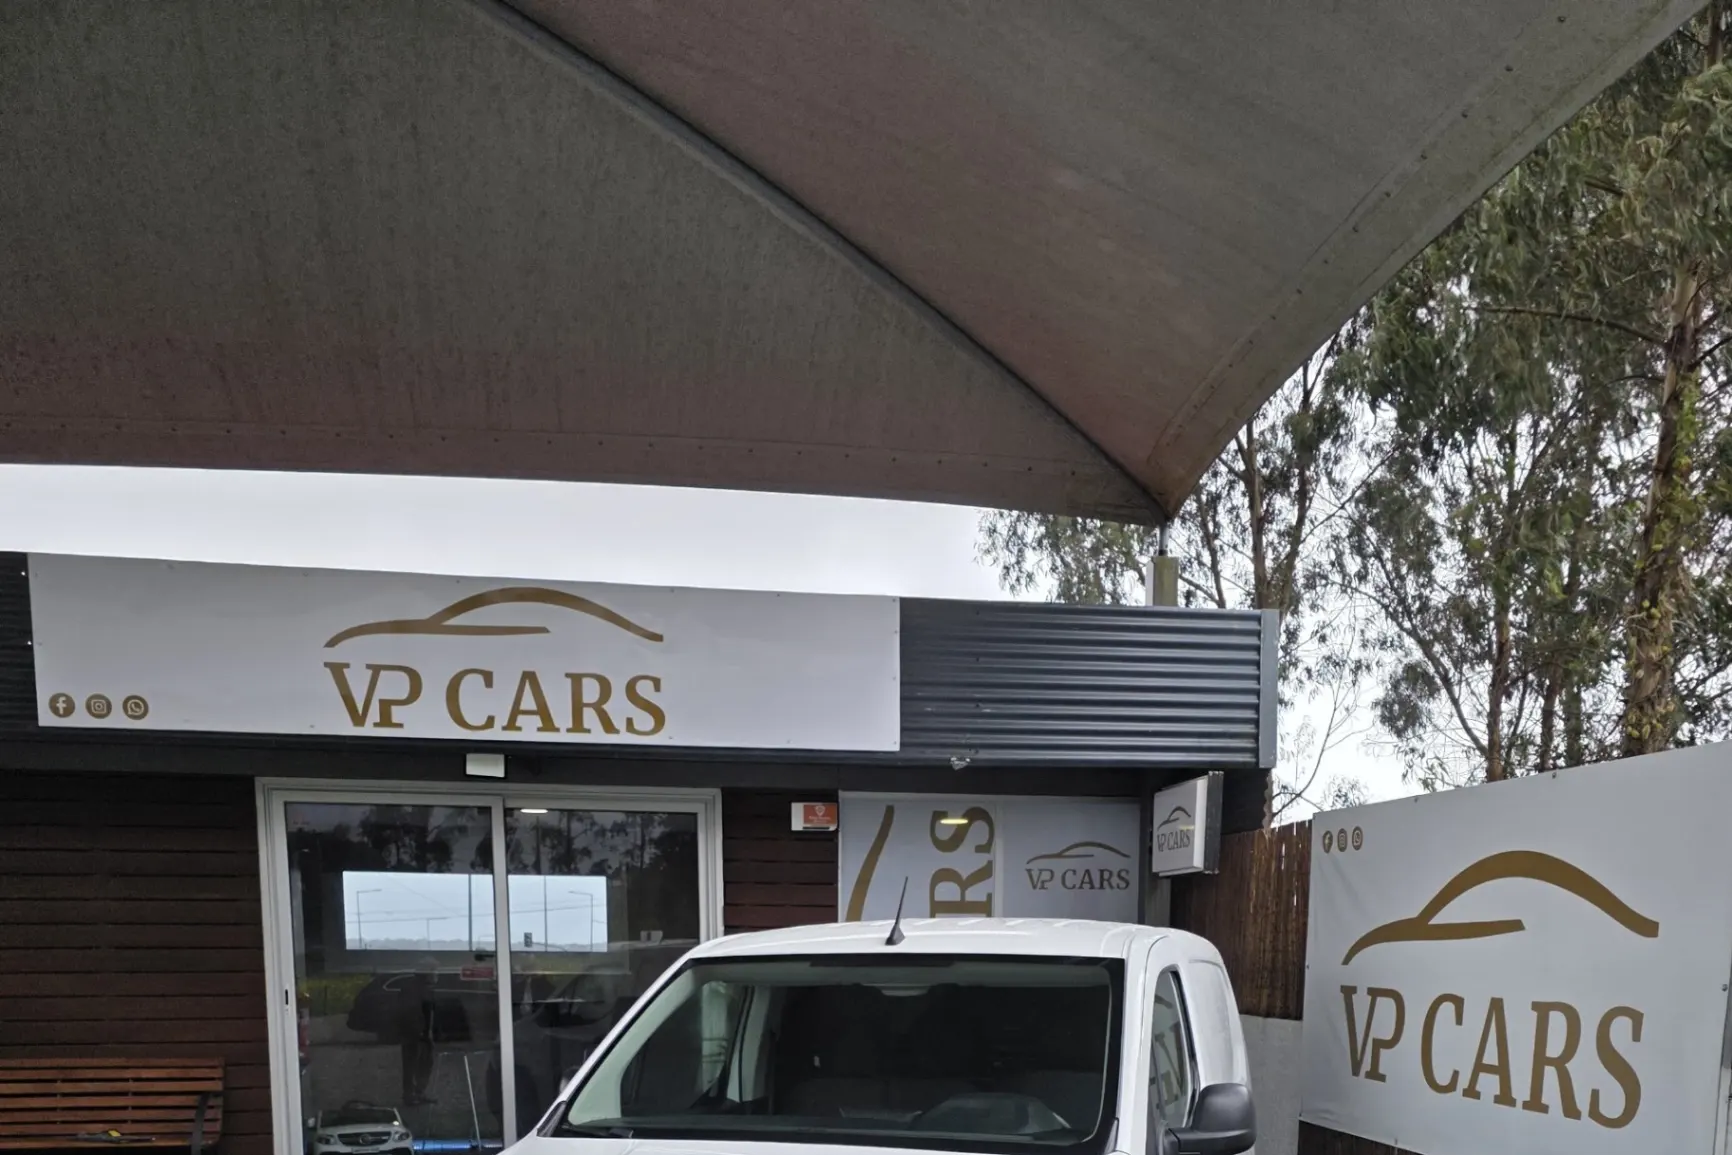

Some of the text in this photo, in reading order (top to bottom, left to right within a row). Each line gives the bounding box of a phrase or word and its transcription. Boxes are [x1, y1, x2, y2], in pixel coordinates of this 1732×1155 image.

[324, 661, 666, 737] VP CARS
[1156, 829, 1191, 852] VP CARS
[1025, 868, 1130, 890] VP CARS
[1340, 984, 1645, 1129] VP CARS
